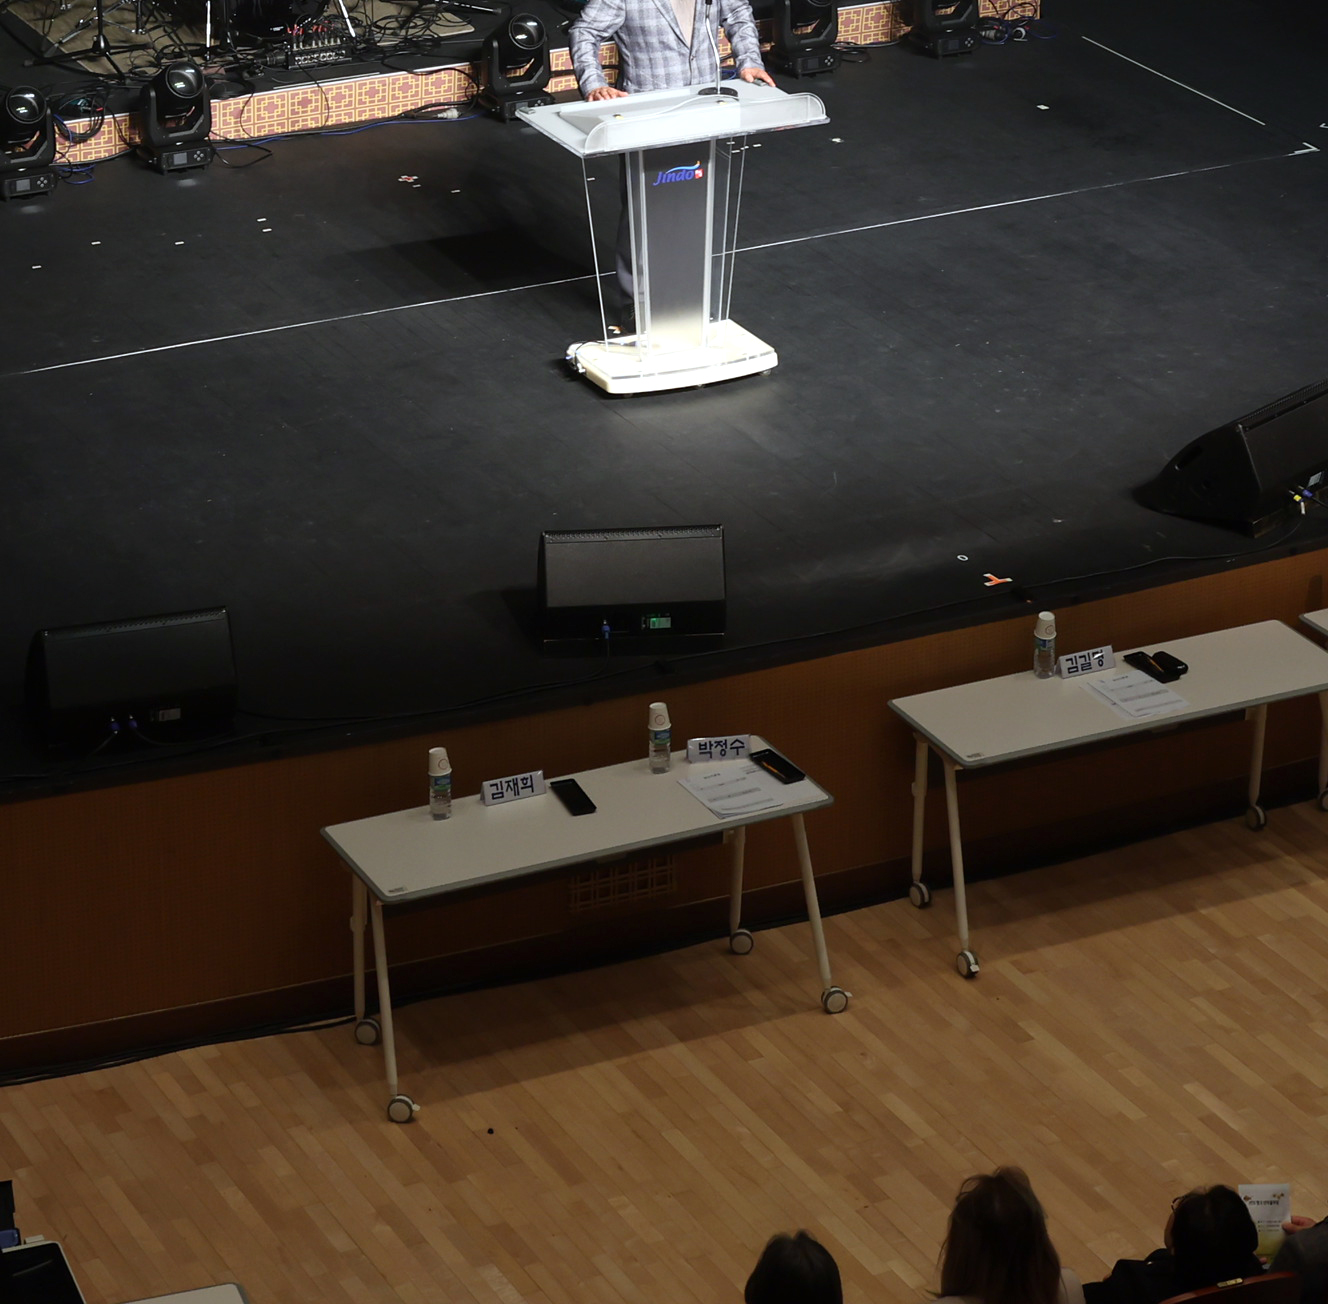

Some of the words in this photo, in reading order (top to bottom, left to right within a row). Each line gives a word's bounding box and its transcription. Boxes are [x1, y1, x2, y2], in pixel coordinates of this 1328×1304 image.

[652, 169, 695, 186] Jindo
[698, 738, 746, 759] 박정수
[489, 774, 535, 801] 김재희
